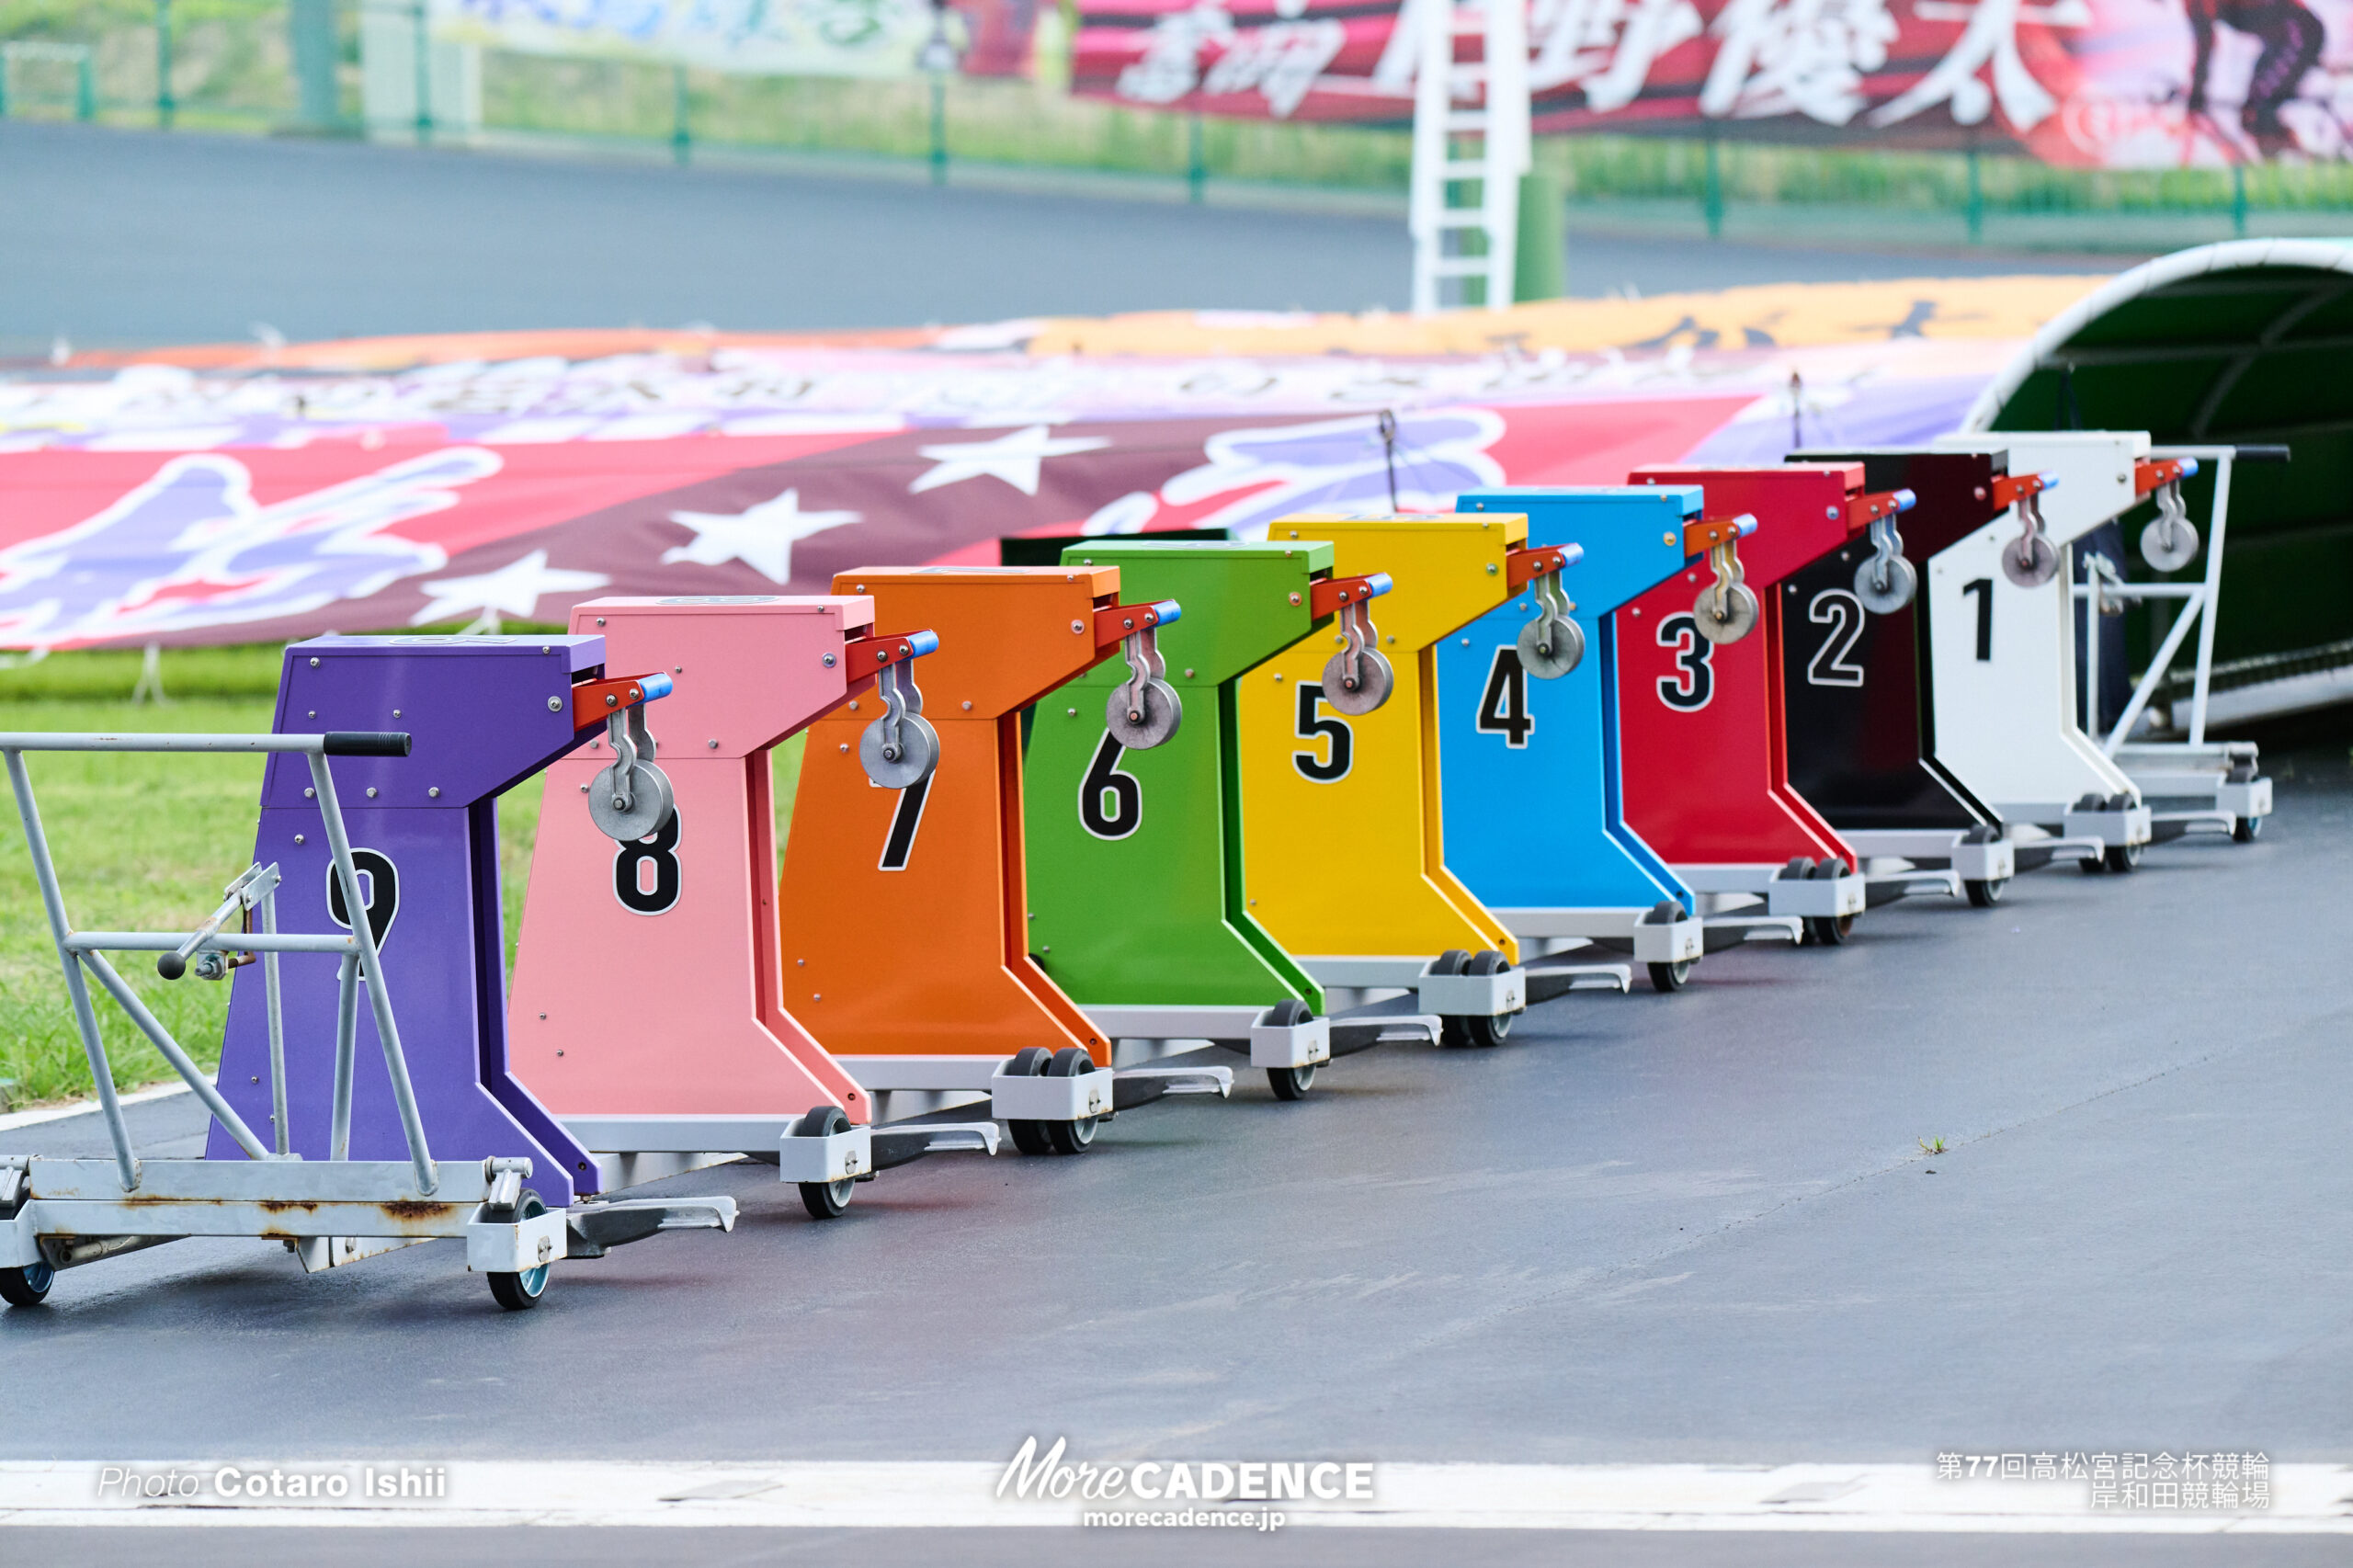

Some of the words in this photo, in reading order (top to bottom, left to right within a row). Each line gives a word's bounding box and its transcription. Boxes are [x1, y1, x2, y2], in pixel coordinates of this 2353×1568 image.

[1655, 611, 1716, 713] 3
[1807, 588, 1866, 688] 2
[1961, 578, 1994, 663] 1
[1292, 680, 1356, 785] 5
[1476, 644, 1536, 750] 4
[1078, 727, 1142, 841] 6
[613, 804, 684, 916] 8
[326, 846, 401, 982] 9
